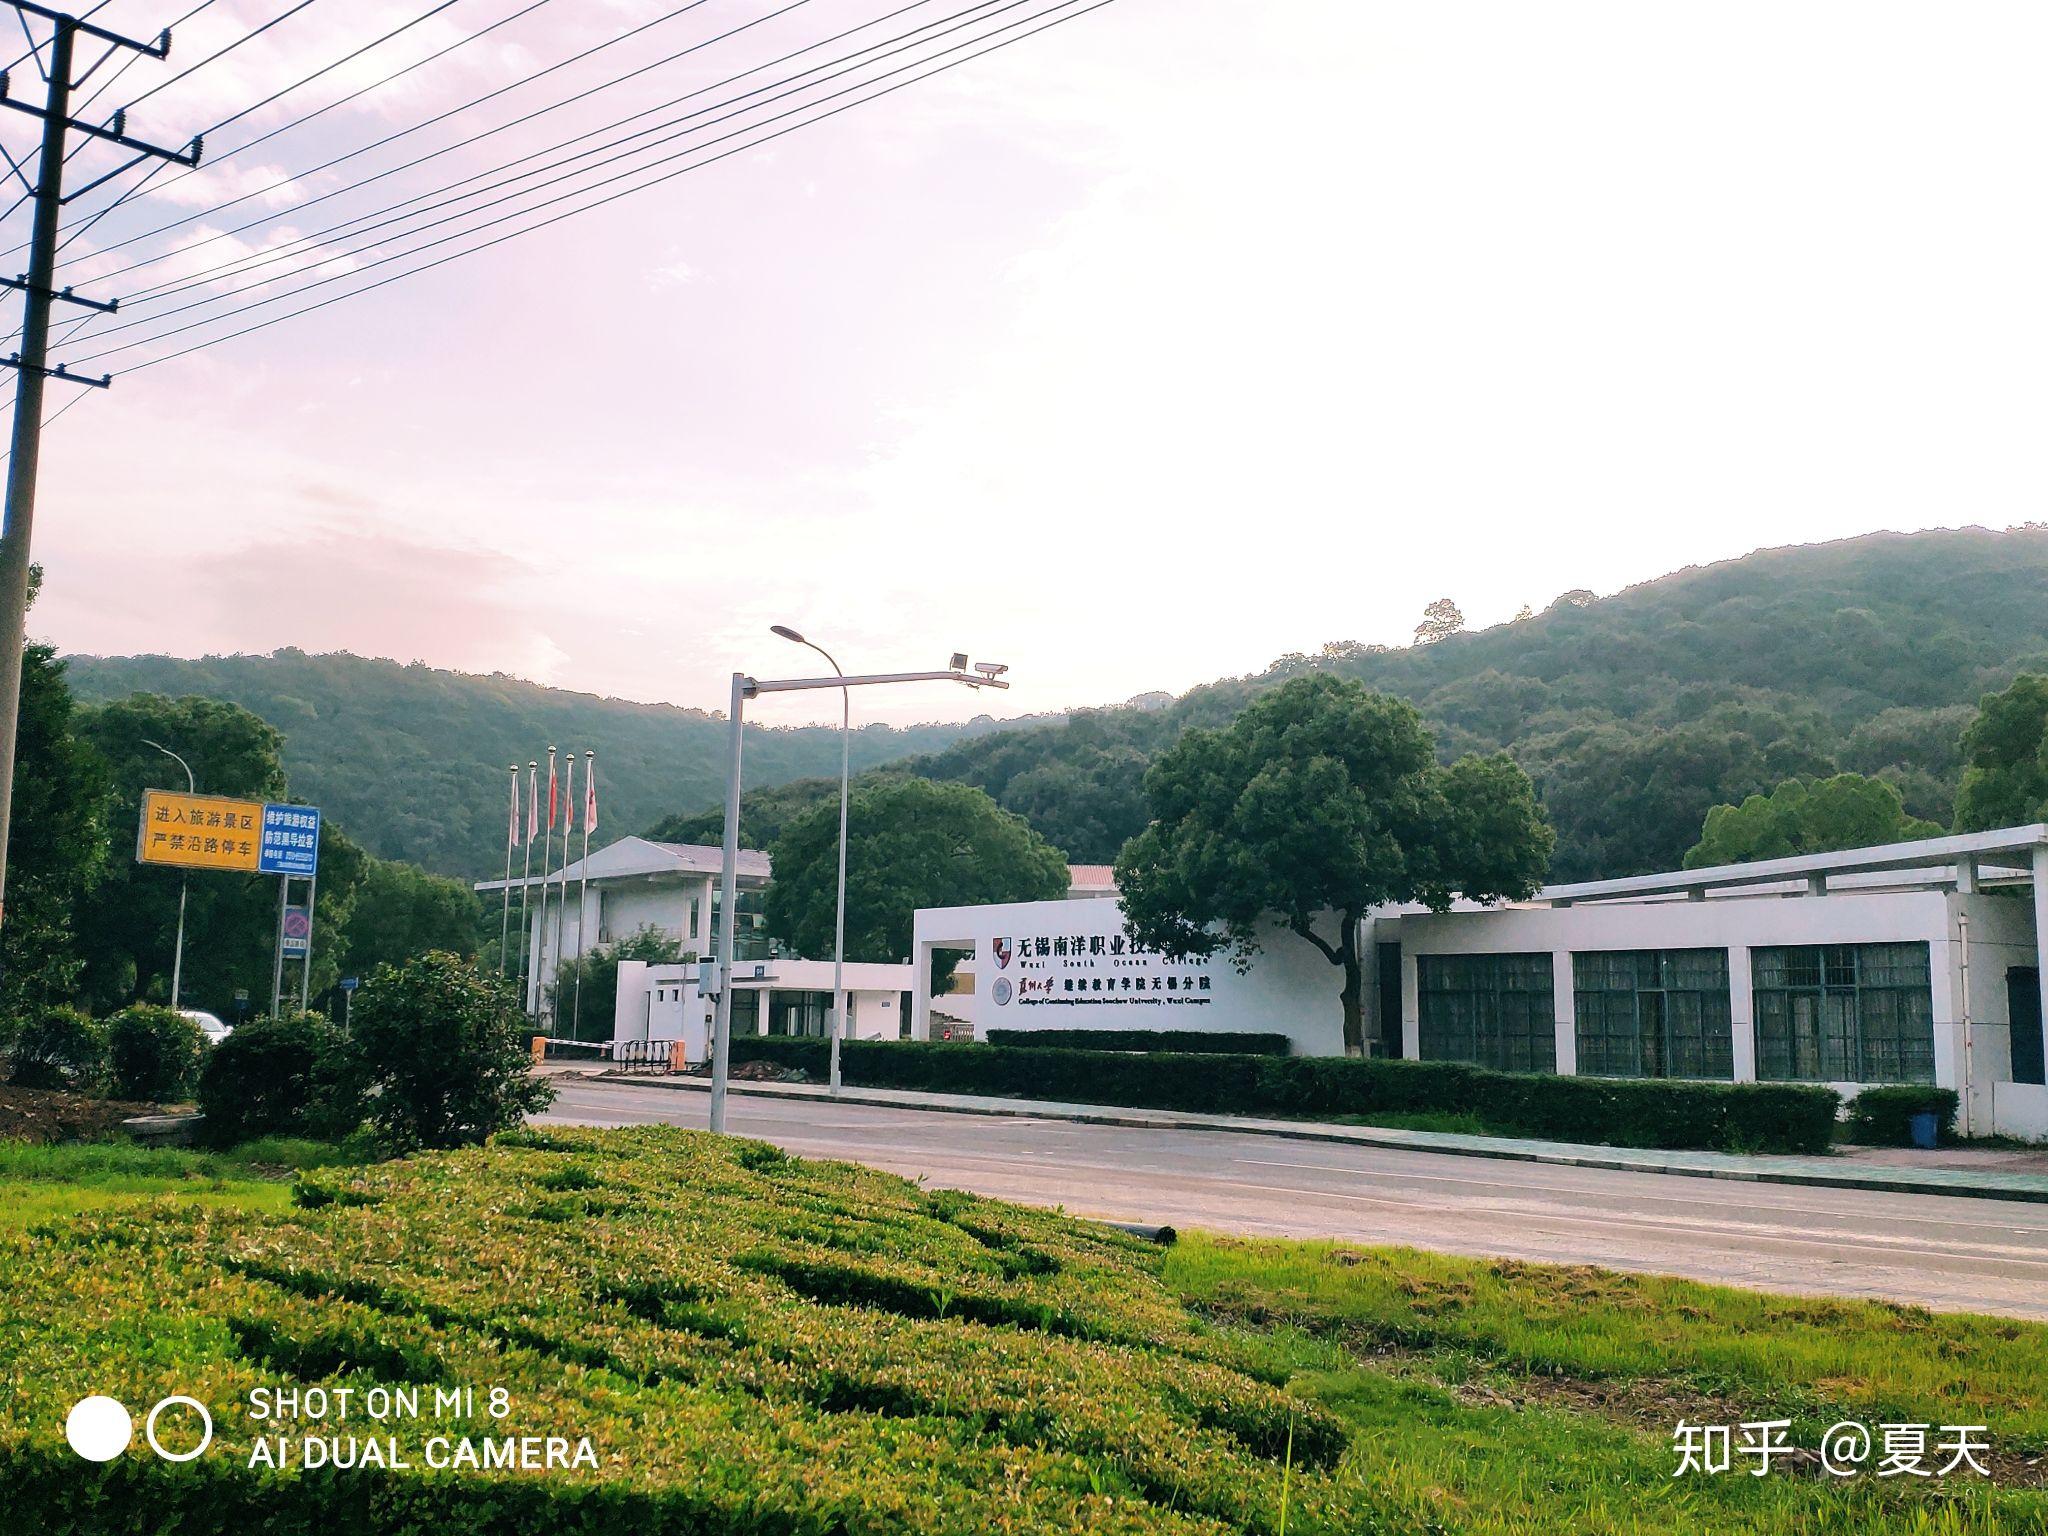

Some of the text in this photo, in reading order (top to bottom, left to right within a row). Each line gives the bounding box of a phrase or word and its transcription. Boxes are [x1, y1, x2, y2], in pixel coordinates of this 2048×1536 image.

[155, 806, 254, 830] 进入旅游景区
[266, 811, 316, 829] 维护旅游权益
[152, 832, 252, 857] 严禁沿路停车
[264, 831, 314, 848] 防范黑导拉客
[1063, 959, 1095, 968] South
[1113, 959, 1147, 967] Ocean
[1063, 976, 1211, 991] 继续教育学院无锡分院
